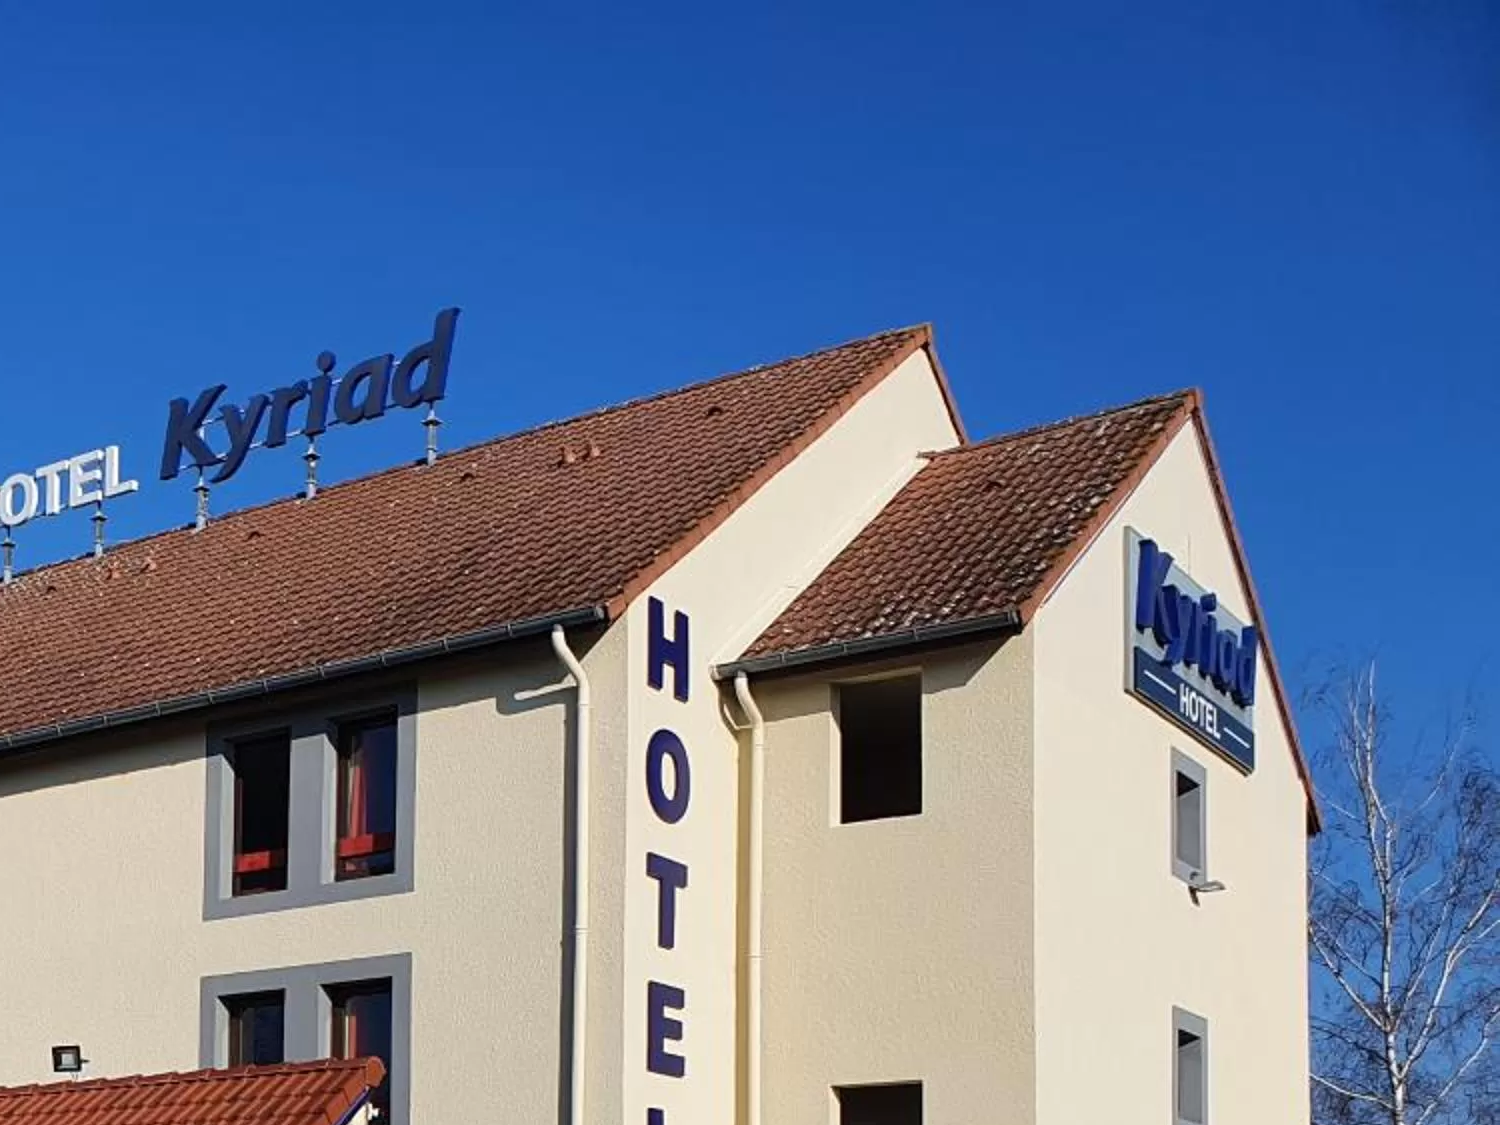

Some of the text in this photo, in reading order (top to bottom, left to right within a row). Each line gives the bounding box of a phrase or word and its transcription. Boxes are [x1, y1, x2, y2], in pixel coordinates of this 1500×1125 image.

[159, 306, 461, 483] Kyriad
[1135, 539, 1257, 709] Kyriad
[1179, 683, 1221, 739] HOTEL
